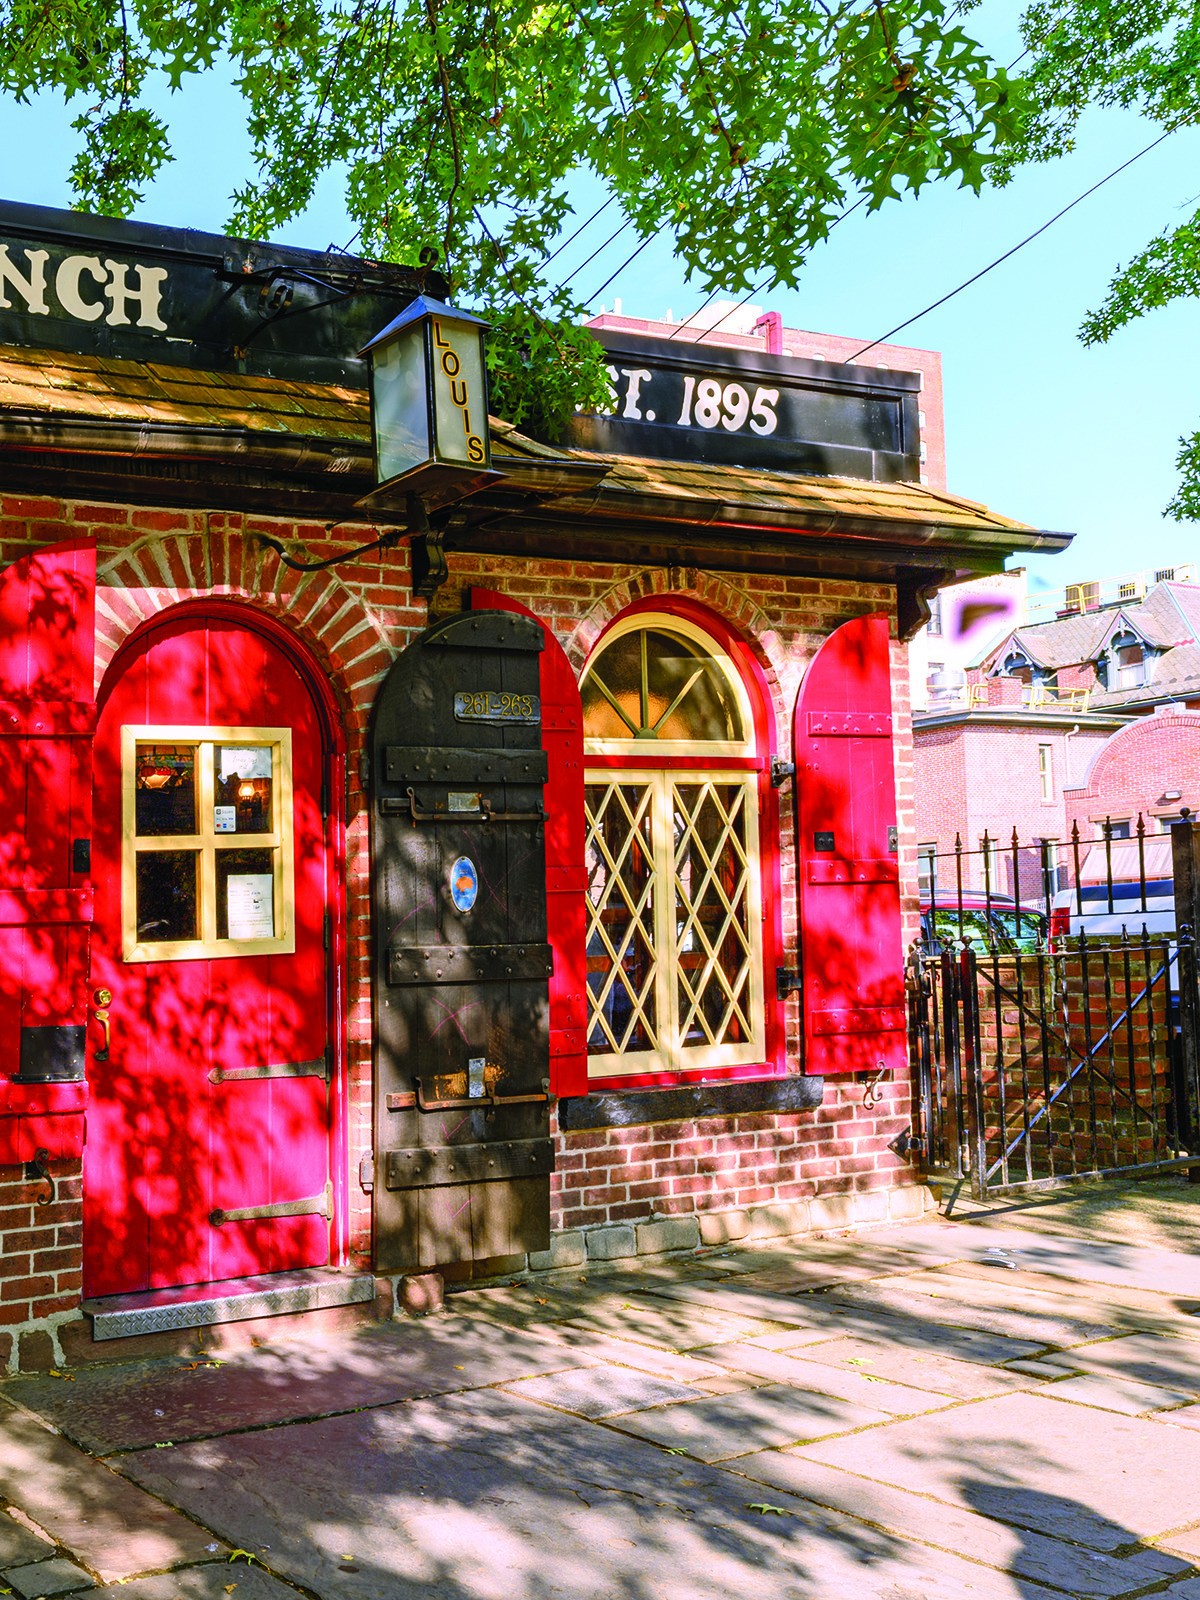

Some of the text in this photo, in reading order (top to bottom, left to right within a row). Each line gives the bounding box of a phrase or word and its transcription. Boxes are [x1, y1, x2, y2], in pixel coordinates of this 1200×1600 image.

[433, 320, 486, 464] LOUIS
[569, 361, 780, 436] ST. 1895
[463, 692, 533, 718] 261-263
